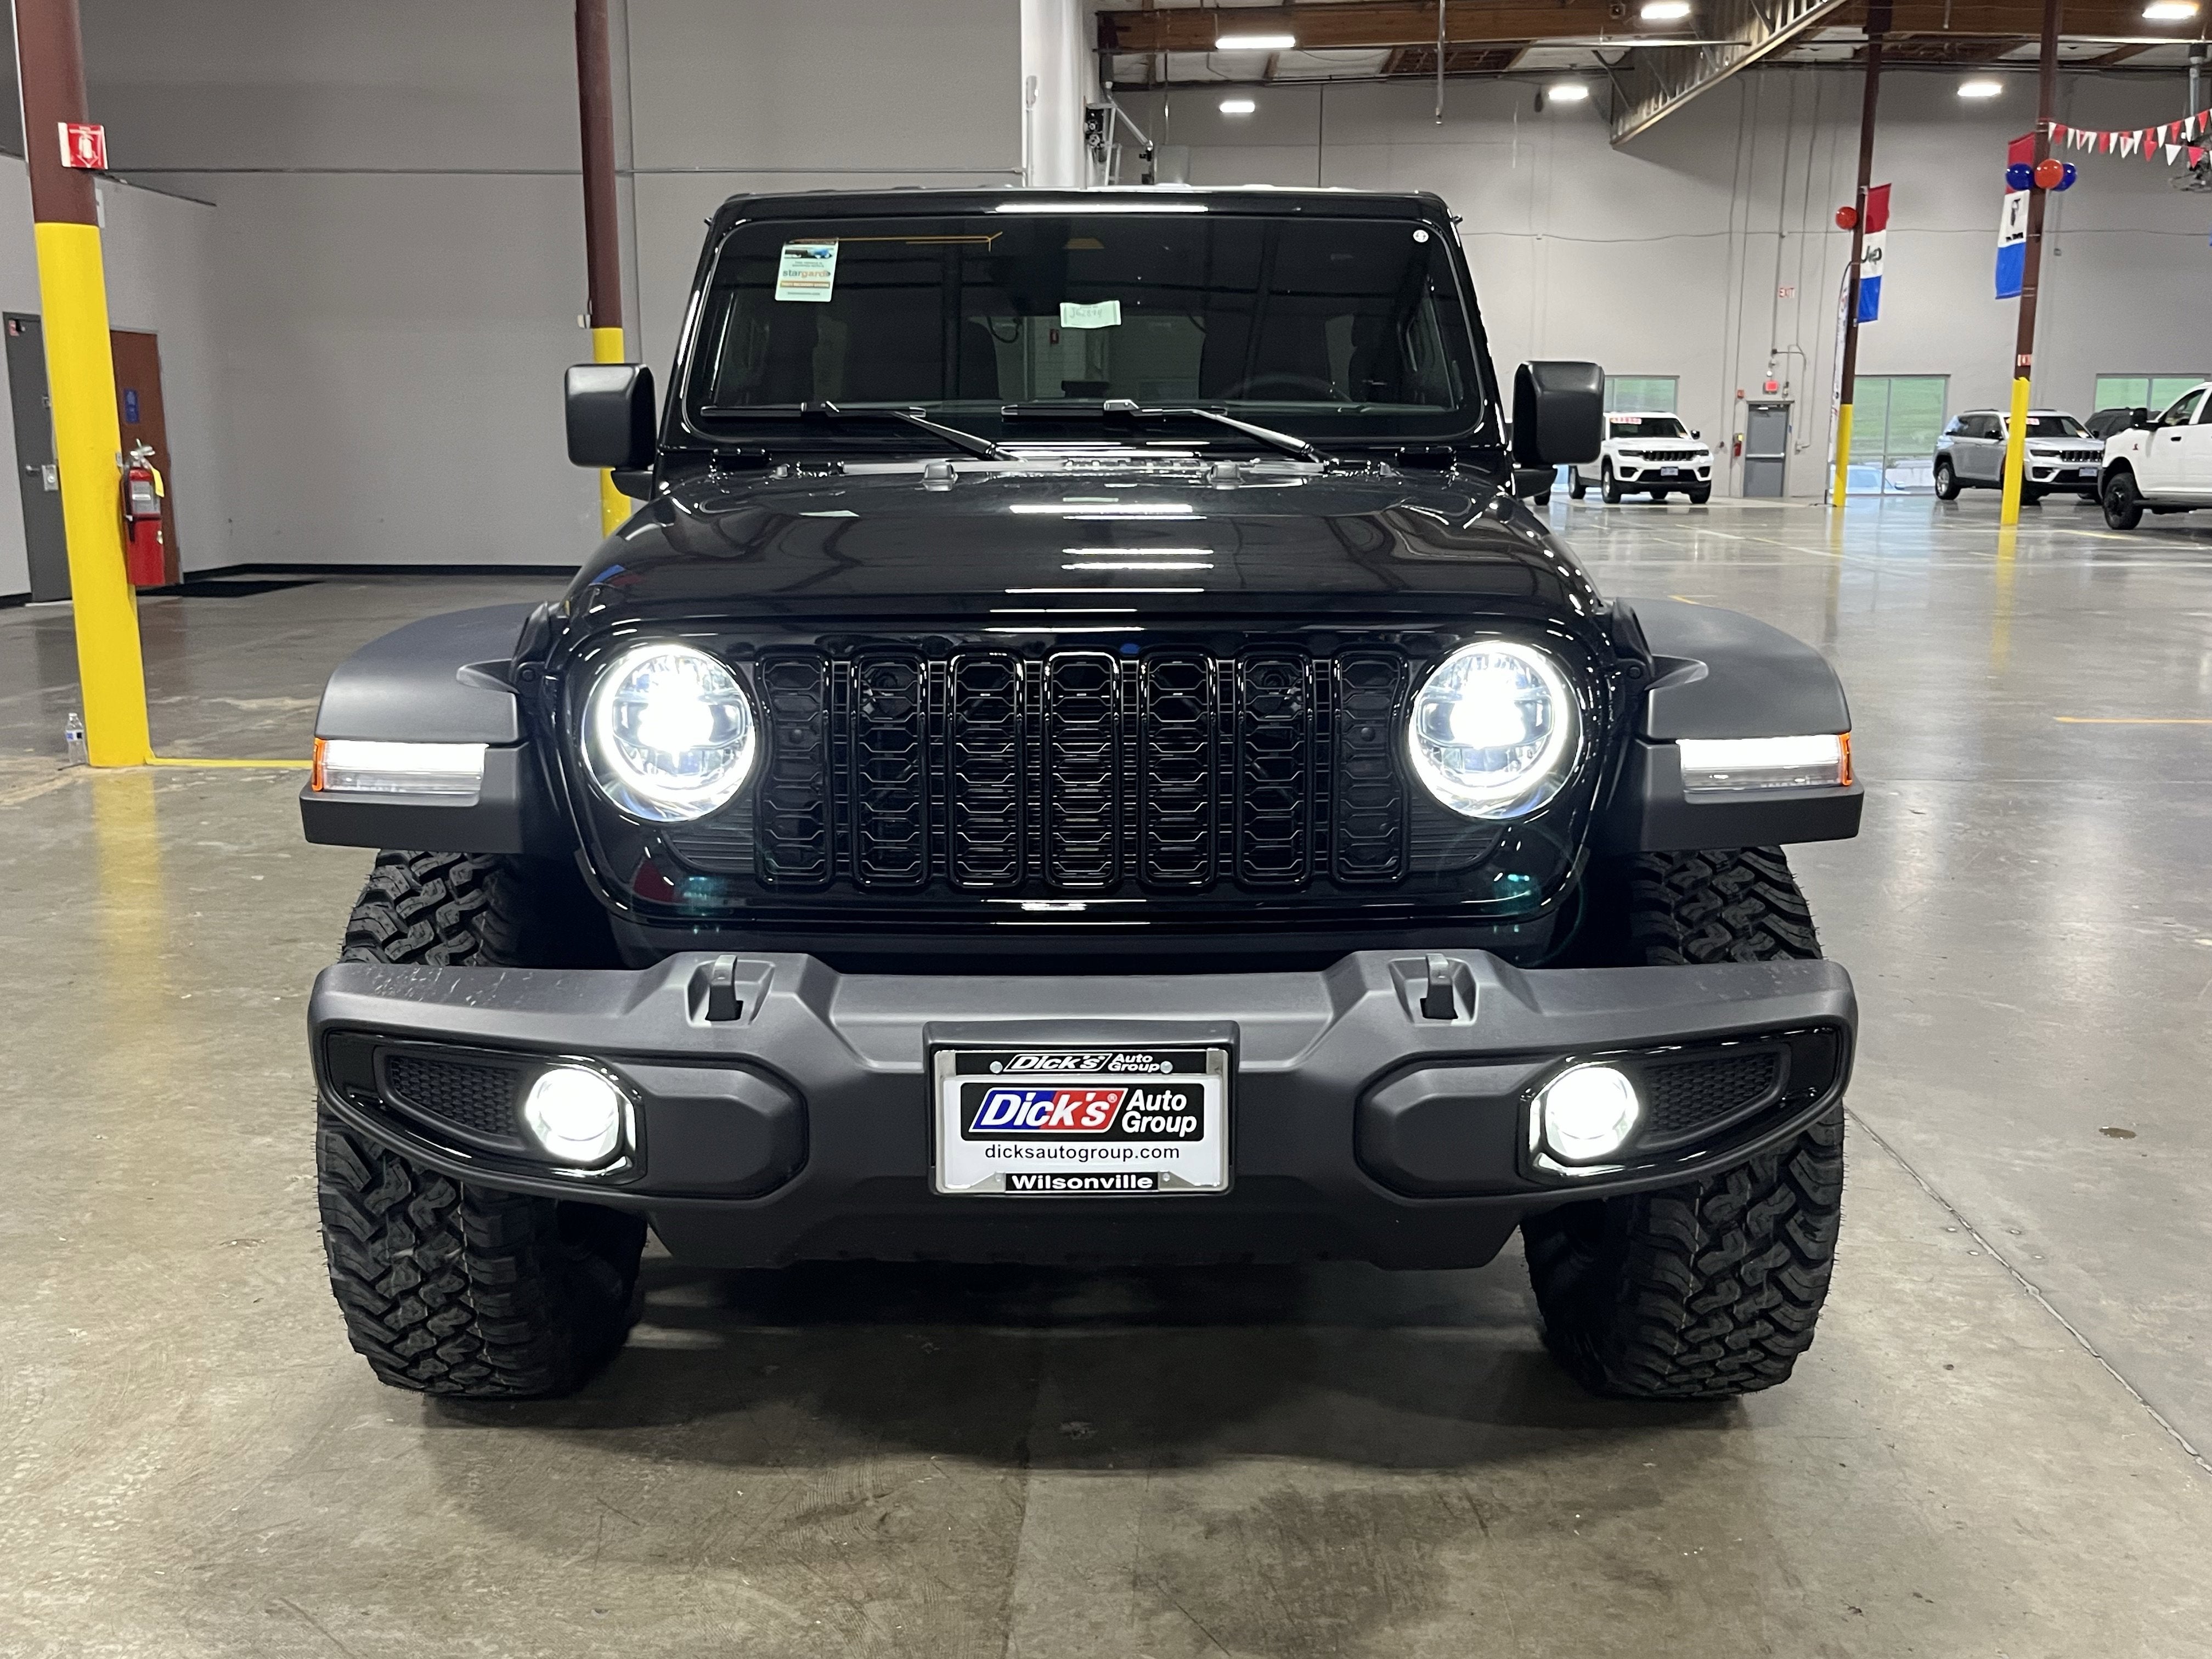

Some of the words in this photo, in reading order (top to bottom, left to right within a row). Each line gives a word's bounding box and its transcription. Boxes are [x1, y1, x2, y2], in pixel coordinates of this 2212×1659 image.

[1011, 1056, 1101, 1069] Dick's
[1111, 1053, 1153, 1063] Auto
[1108, 1062, 1160, 1073] Group
[1126, 1090, 1187, 1111] Auto
[980, 1092, 1110, 1127] Dick's
[1122, 1112, 1197, 1137] Group
[985, 1144, 1180, 1162] dicksautogroup.com
[1012, 1174, 1153, 1189] Wilsonville
